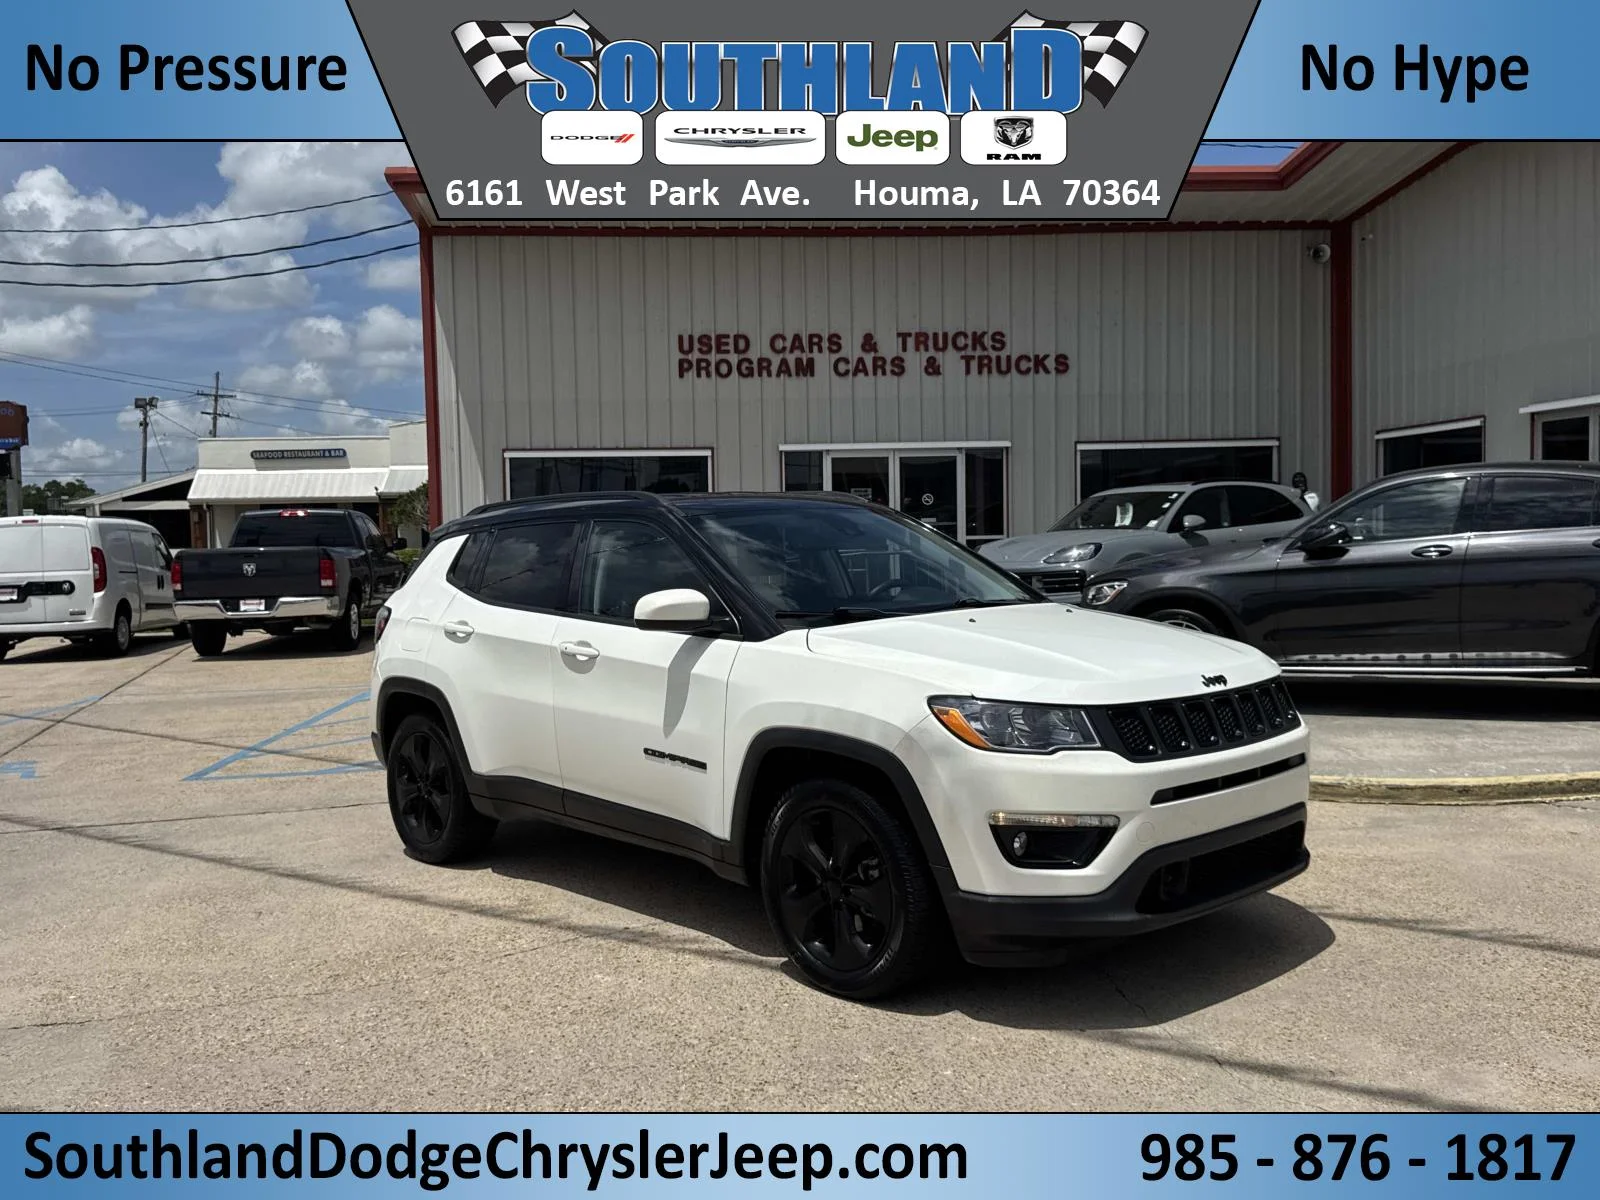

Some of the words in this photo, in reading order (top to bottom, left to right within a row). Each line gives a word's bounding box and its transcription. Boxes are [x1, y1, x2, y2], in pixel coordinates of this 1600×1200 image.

[678, 333, 751, 355] USED
[769, 333, 843, 354] CARS
[860, 332, 879, 354] &
[897, 331, 1007, 352] TRUCKS
[678, 357, 816, 379] PROGRAM
[833, 356, 906, 377] CARS
[923, 355, 942, 377] &
[960, 354, 1070, 376] TRUCKS
